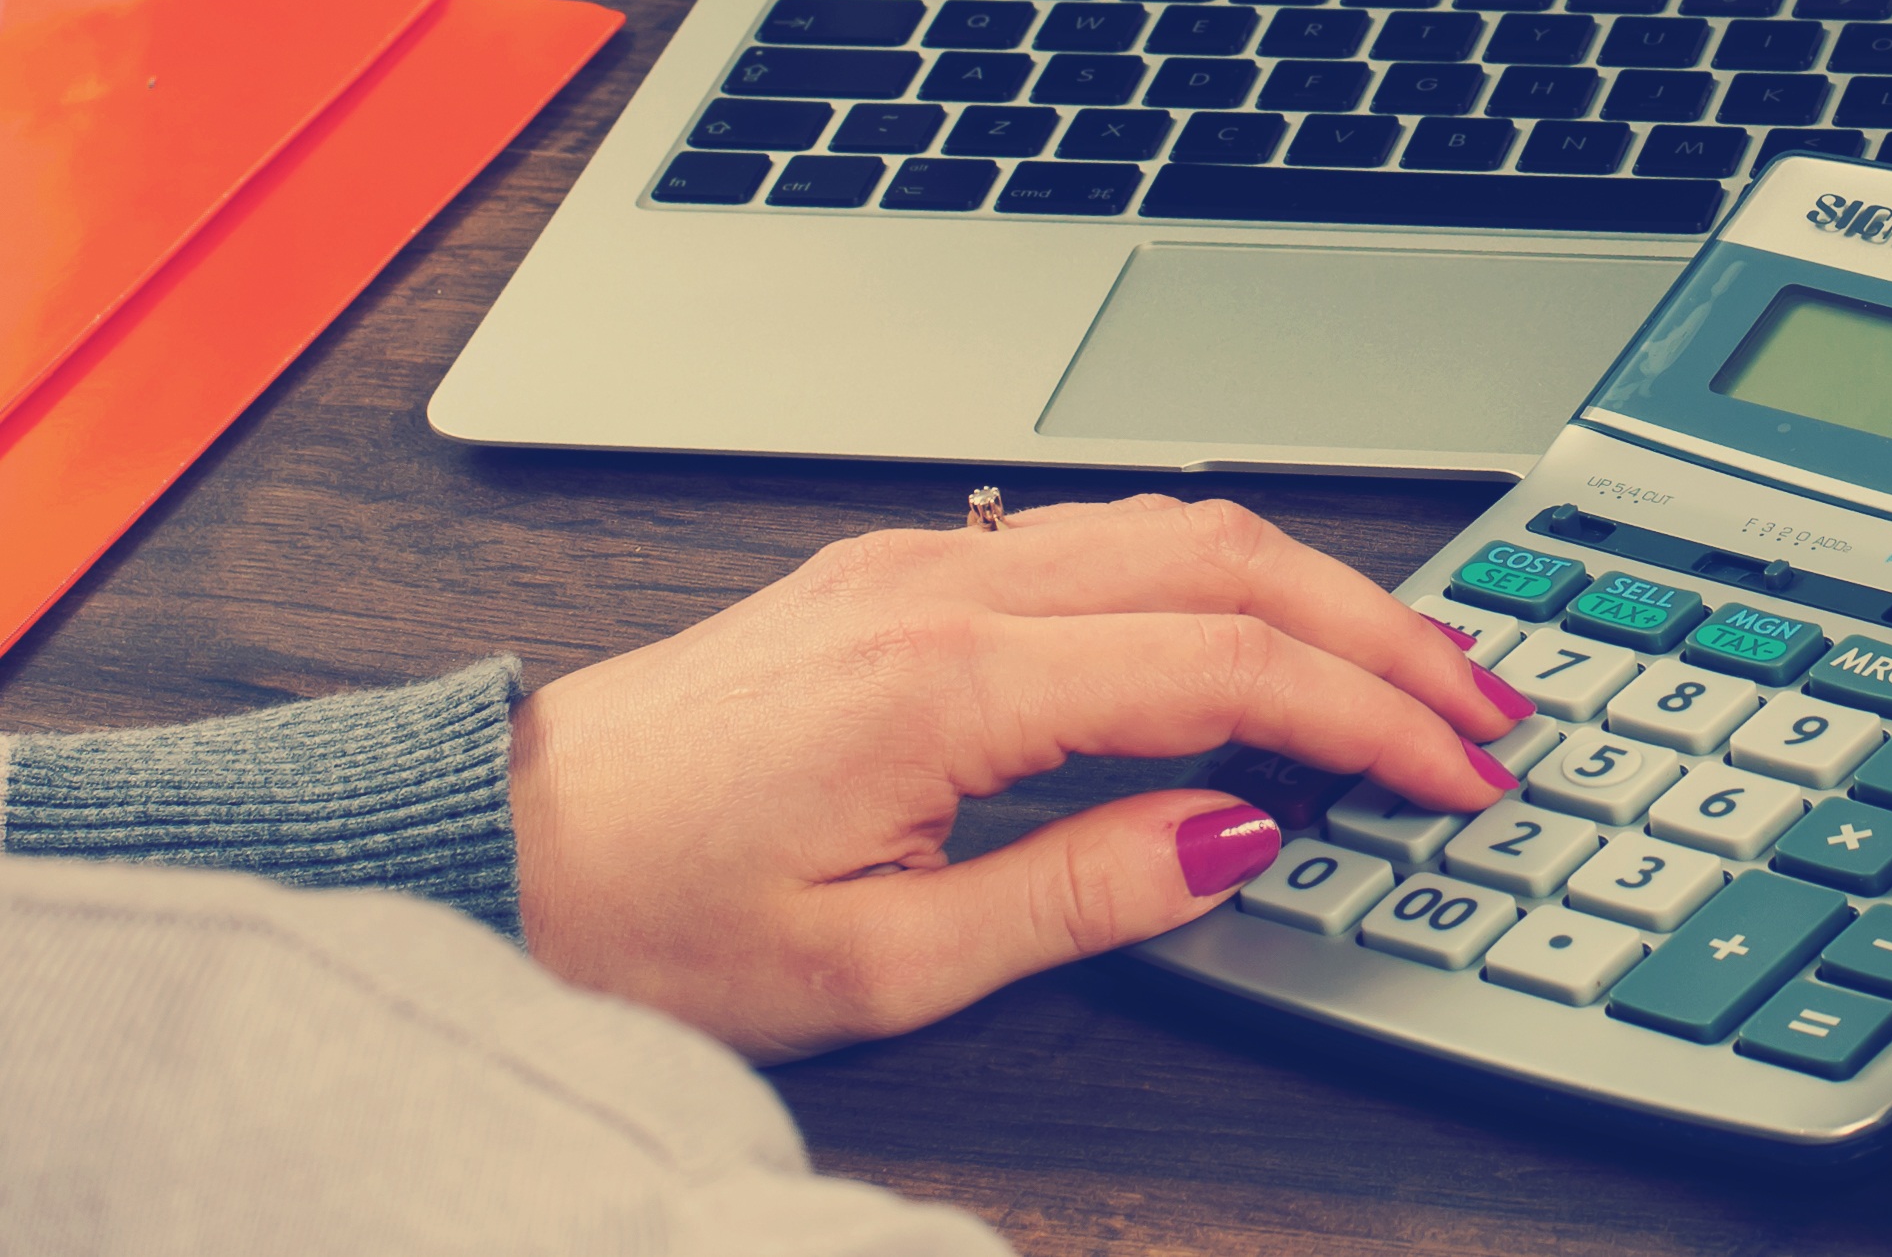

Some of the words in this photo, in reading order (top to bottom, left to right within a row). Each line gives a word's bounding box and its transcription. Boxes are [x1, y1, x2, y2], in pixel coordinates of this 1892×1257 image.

[1487, 546, 1572, 578] COST
[1483, 568, 1534, 593] SET
[1606, 576, 1676, 610] SELL
[1586, 593, 1662, 628] TAX+
[1725, 608, 1803, 641] MGN
[1535, 650, 1592, 679] 7
[1657, 683, 1706, 712] 8
[1783, 716, 1829, 745] 9
[1574, 746, 1629, 777] 5
[1699, 788, 1744, 817] 6
[1488, 821, 1544, 856] 2
[1614, 856, 1667, 890] 3
[1393, 887, 1480, 931] 00
